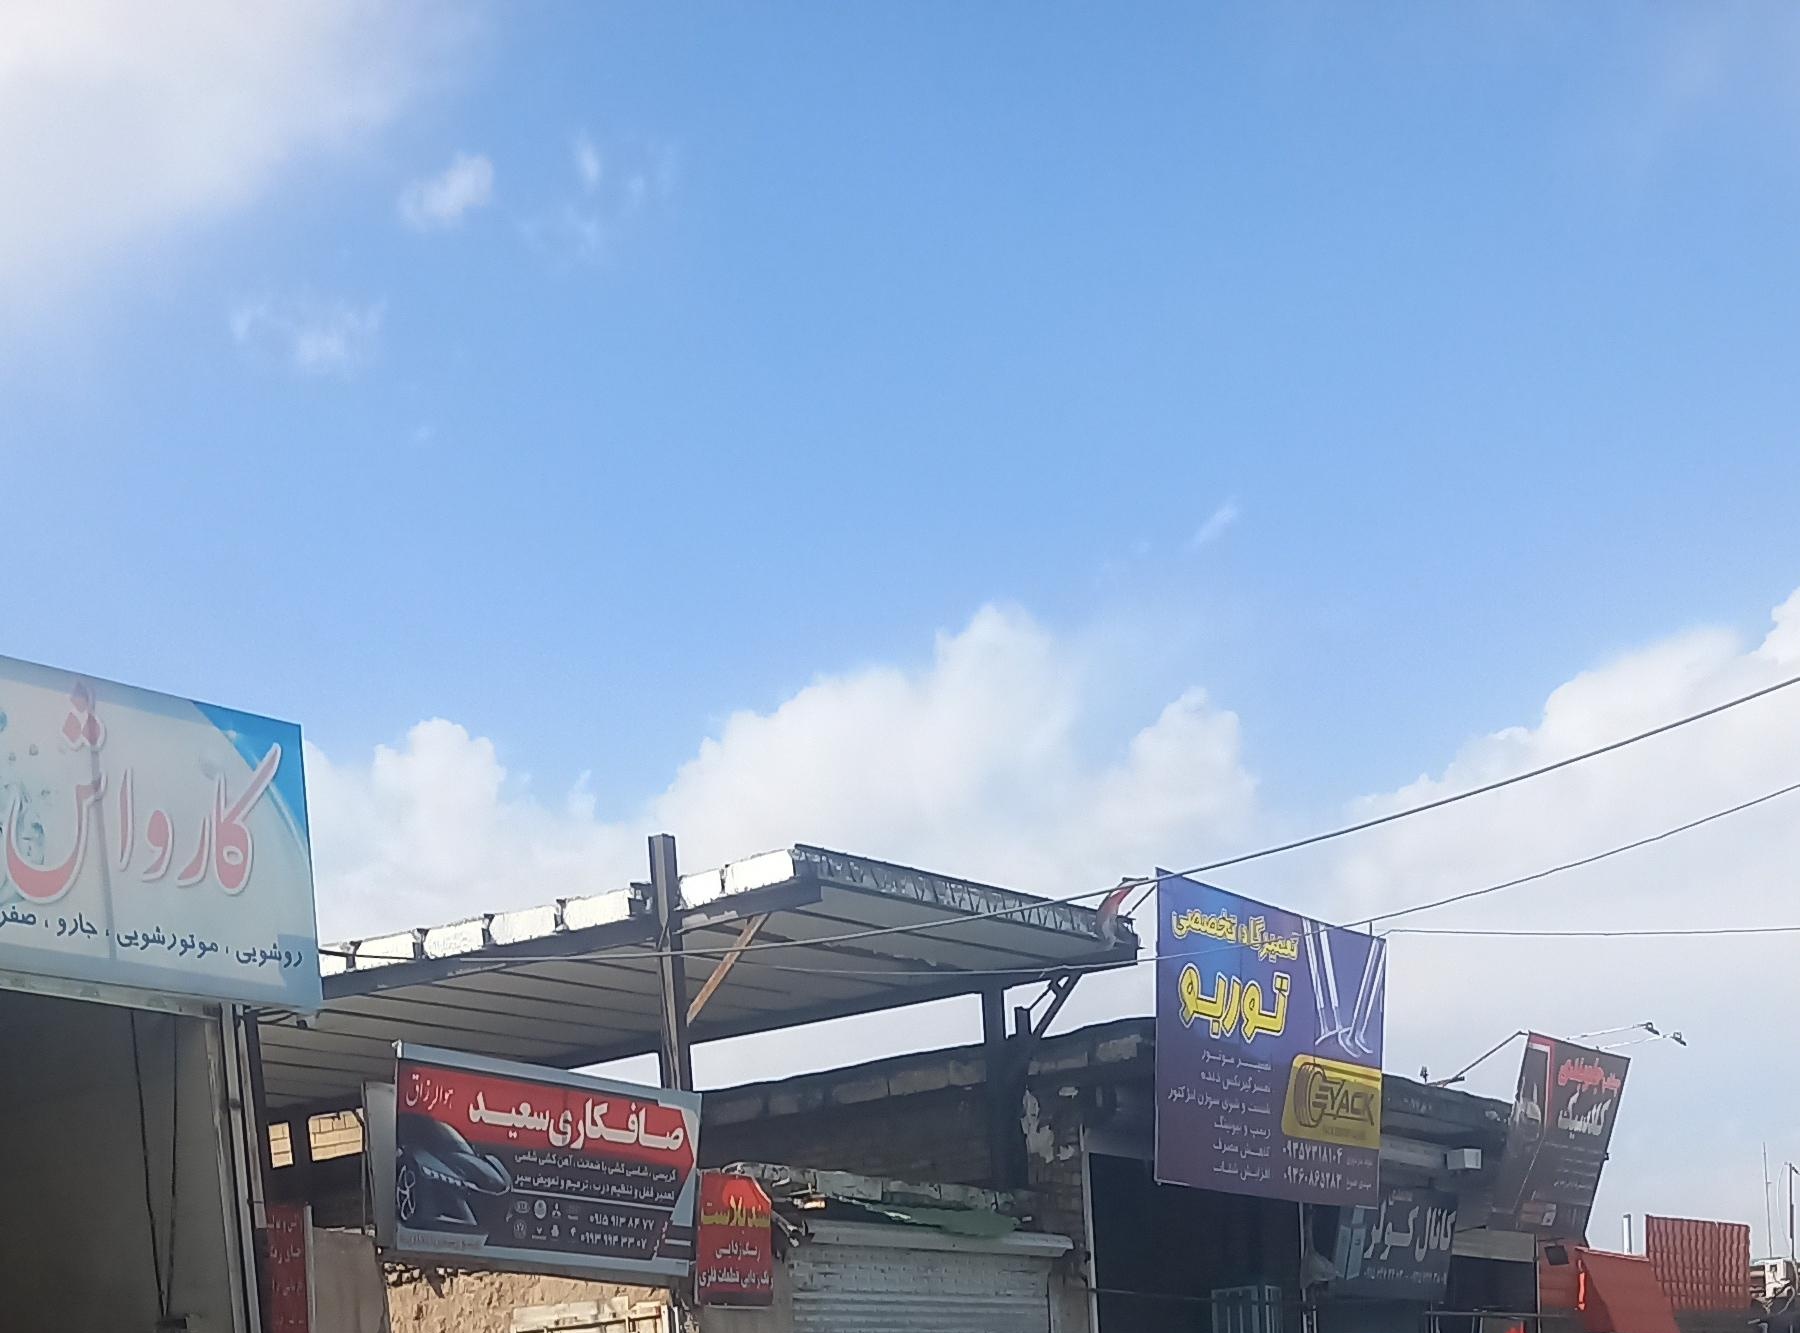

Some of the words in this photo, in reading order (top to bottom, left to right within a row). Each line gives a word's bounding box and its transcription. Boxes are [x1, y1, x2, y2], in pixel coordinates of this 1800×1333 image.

[1171, 907, 1238, 944] تخصصی
[1238, 915, 1300, 963] تعمیرگاه
[1178, 962, 1291, 1044] توربو
[468, 1090, 549, 1139] سعید
[549, 1098, 685, 1151] صافکاری
[1363, 1199, 1420, 1261] کولر
[1414, 1206, 1457, 1263] کانال
